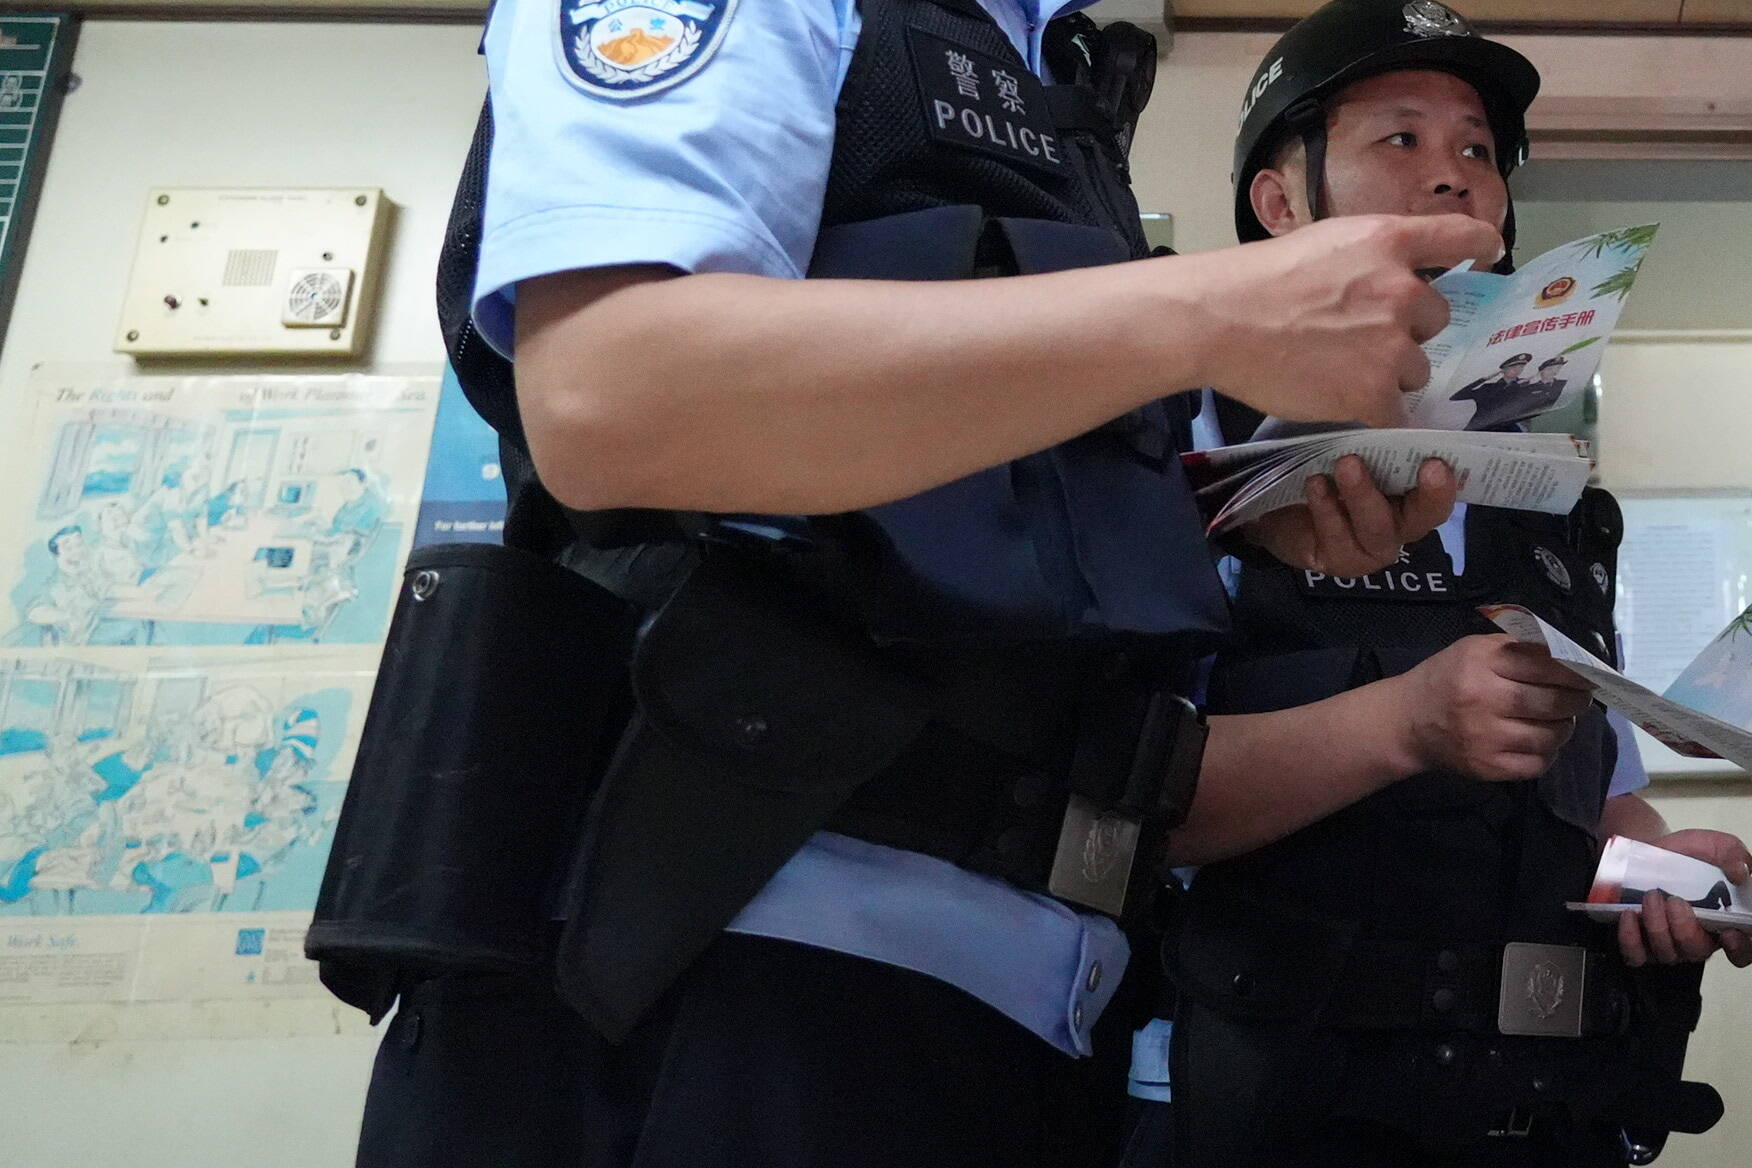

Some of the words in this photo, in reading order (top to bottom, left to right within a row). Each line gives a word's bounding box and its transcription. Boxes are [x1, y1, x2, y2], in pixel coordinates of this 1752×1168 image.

[945, 49, 1027, 116] 警察
[934, 99, 1061, 164] POLICE
[1486, 309, 1596, 348] 法律宣传手册
